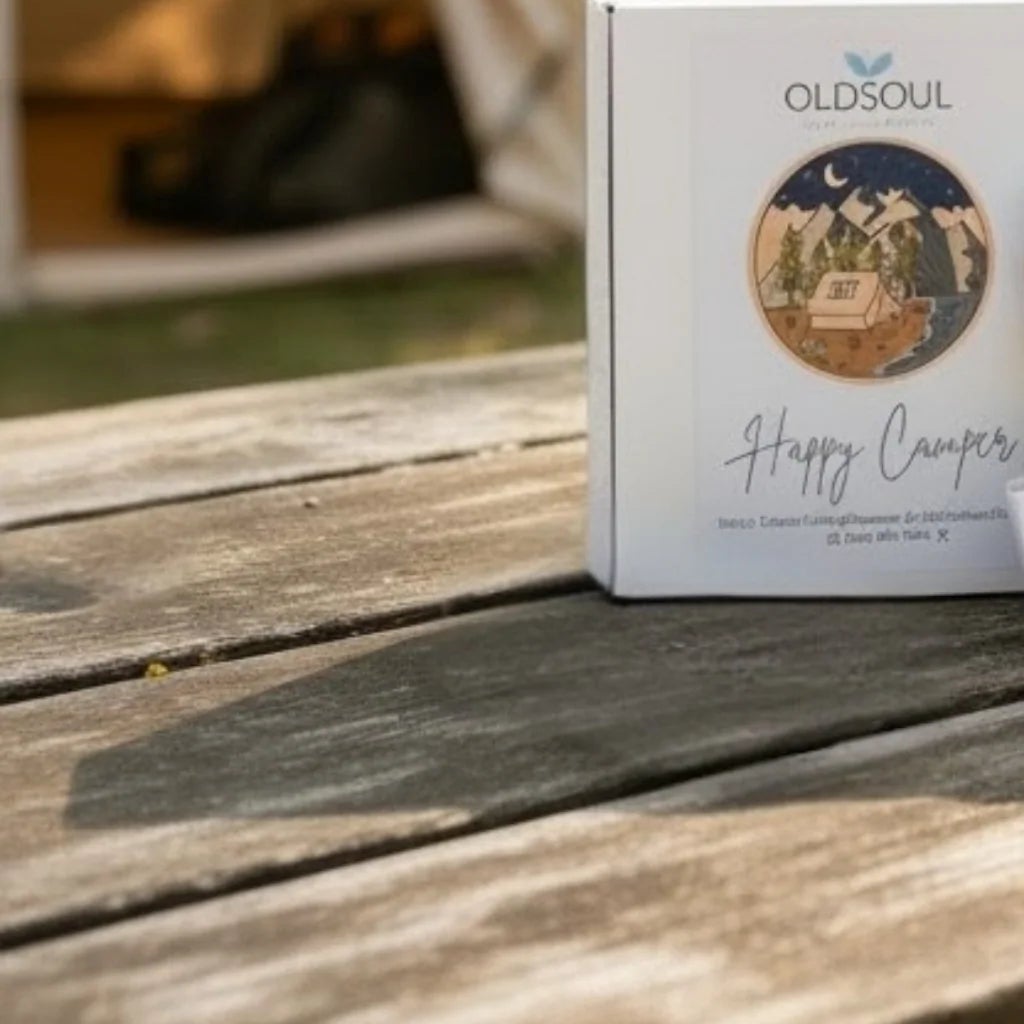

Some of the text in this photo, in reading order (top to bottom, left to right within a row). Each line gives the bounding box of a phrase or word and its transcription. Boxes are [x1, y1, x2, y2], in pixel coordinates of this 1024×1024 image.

[784, 80, 953, 112] OLDSOUL
[724, 402, 1019, 505] Happy Camper
